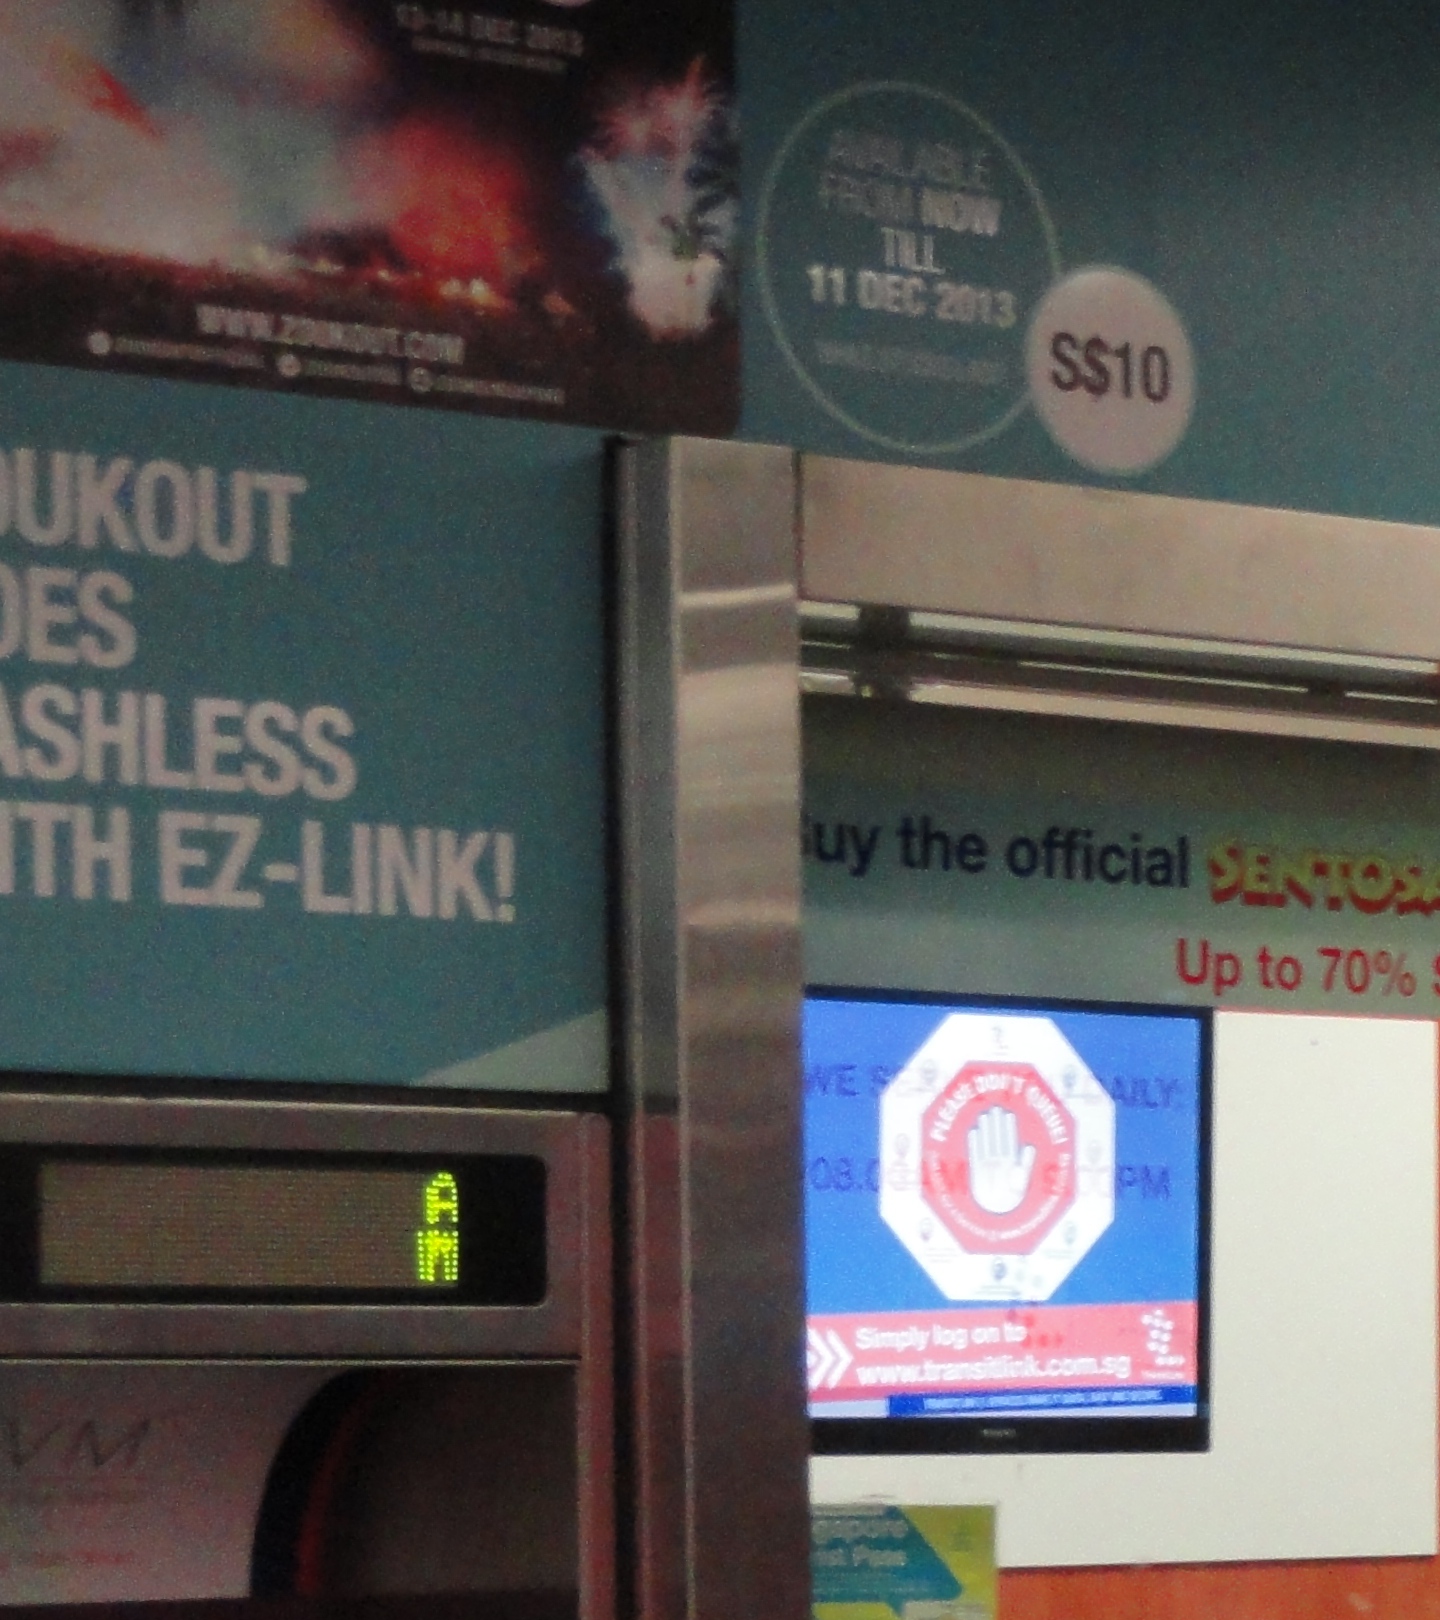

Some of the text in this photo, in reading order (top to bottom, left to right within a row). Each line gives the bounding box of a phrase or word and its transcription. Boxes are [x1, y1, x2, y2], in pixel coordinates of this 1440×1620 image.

[806, 263, 1018, 330] 11 DEC 2013
[0, 446, 308, 566] UKOUT
[157, 810, 517, 925] EZ-LINK!
[896, 815, 989, 874] the
[1005, 826, 1191, 889] official
[1175, 936, 1243, 996] Up
[1257, 945, 1303, 992] to
[1316, 946, 1418, 998] 70%
[855, 1321, 1028, 1353] Simply log on to
